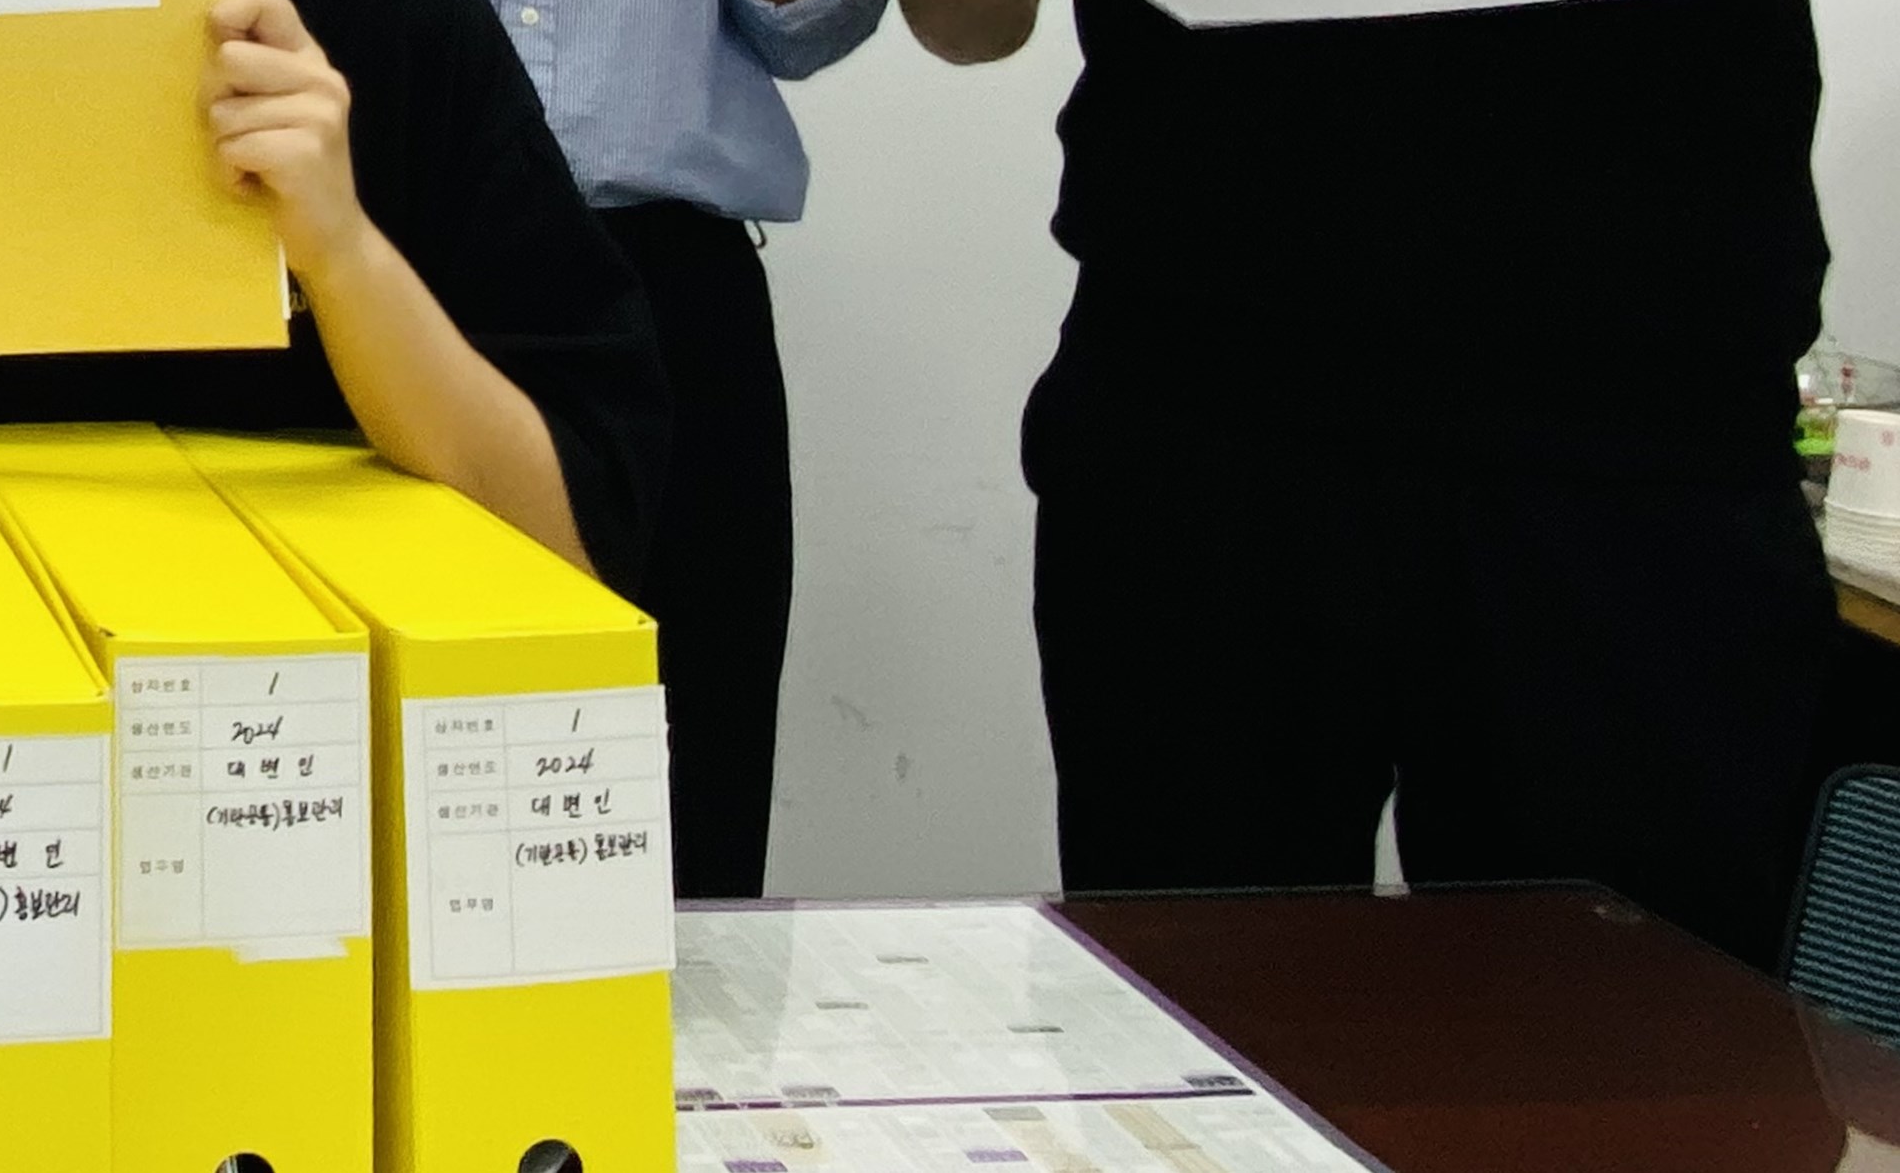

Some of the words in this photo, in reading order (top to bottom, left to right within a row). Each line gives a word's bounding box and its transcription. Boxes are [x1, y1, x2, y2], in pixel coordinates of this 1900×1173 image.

[268, 672, 279, 695] 1
[231, 715, 284, 744] 2024
[572, 708, 581, 732] 1
[3, 743, 13, 773] 1
[536, 747, 595, 777] 2024
